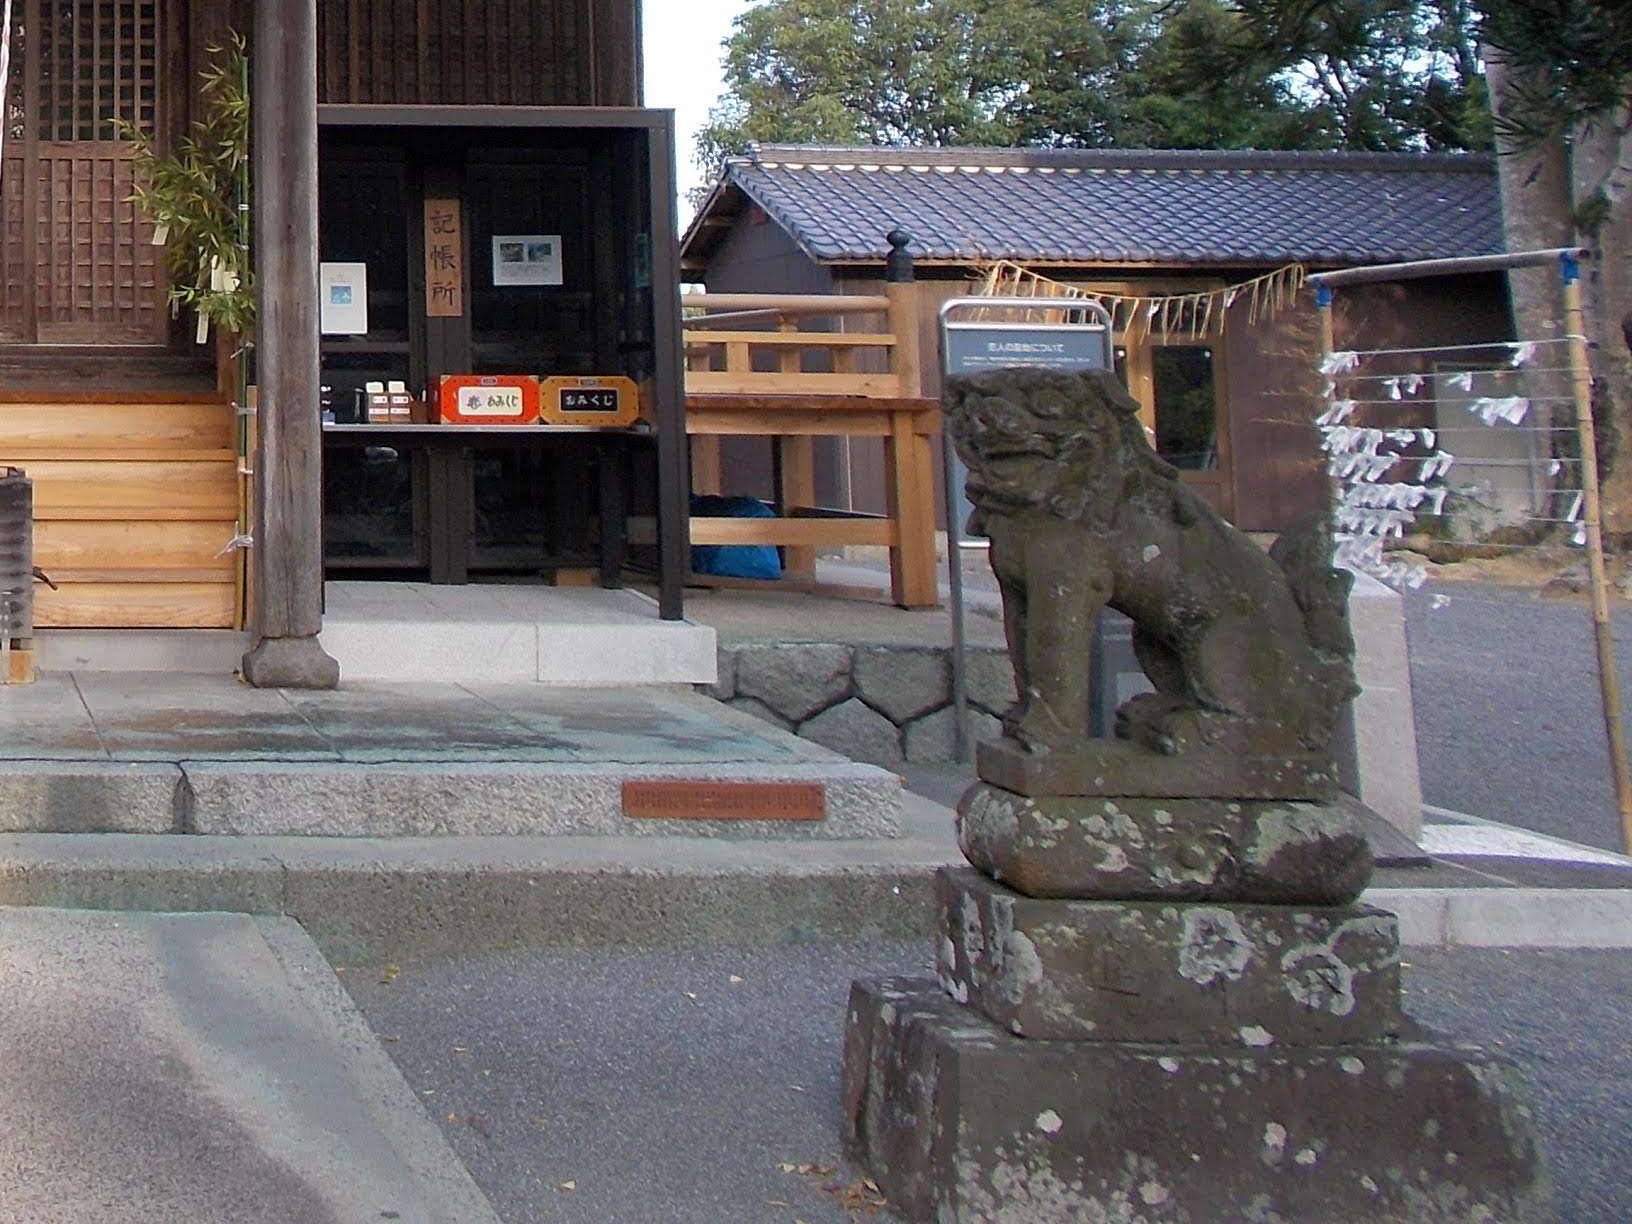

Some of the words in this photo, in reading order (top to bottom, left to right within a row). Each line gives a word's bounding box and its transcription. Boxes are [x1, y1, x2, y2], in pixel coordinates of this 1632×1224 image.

[429, 209, 457, 307] 記帳所
[565, 394, 615, 406] おみくじ
